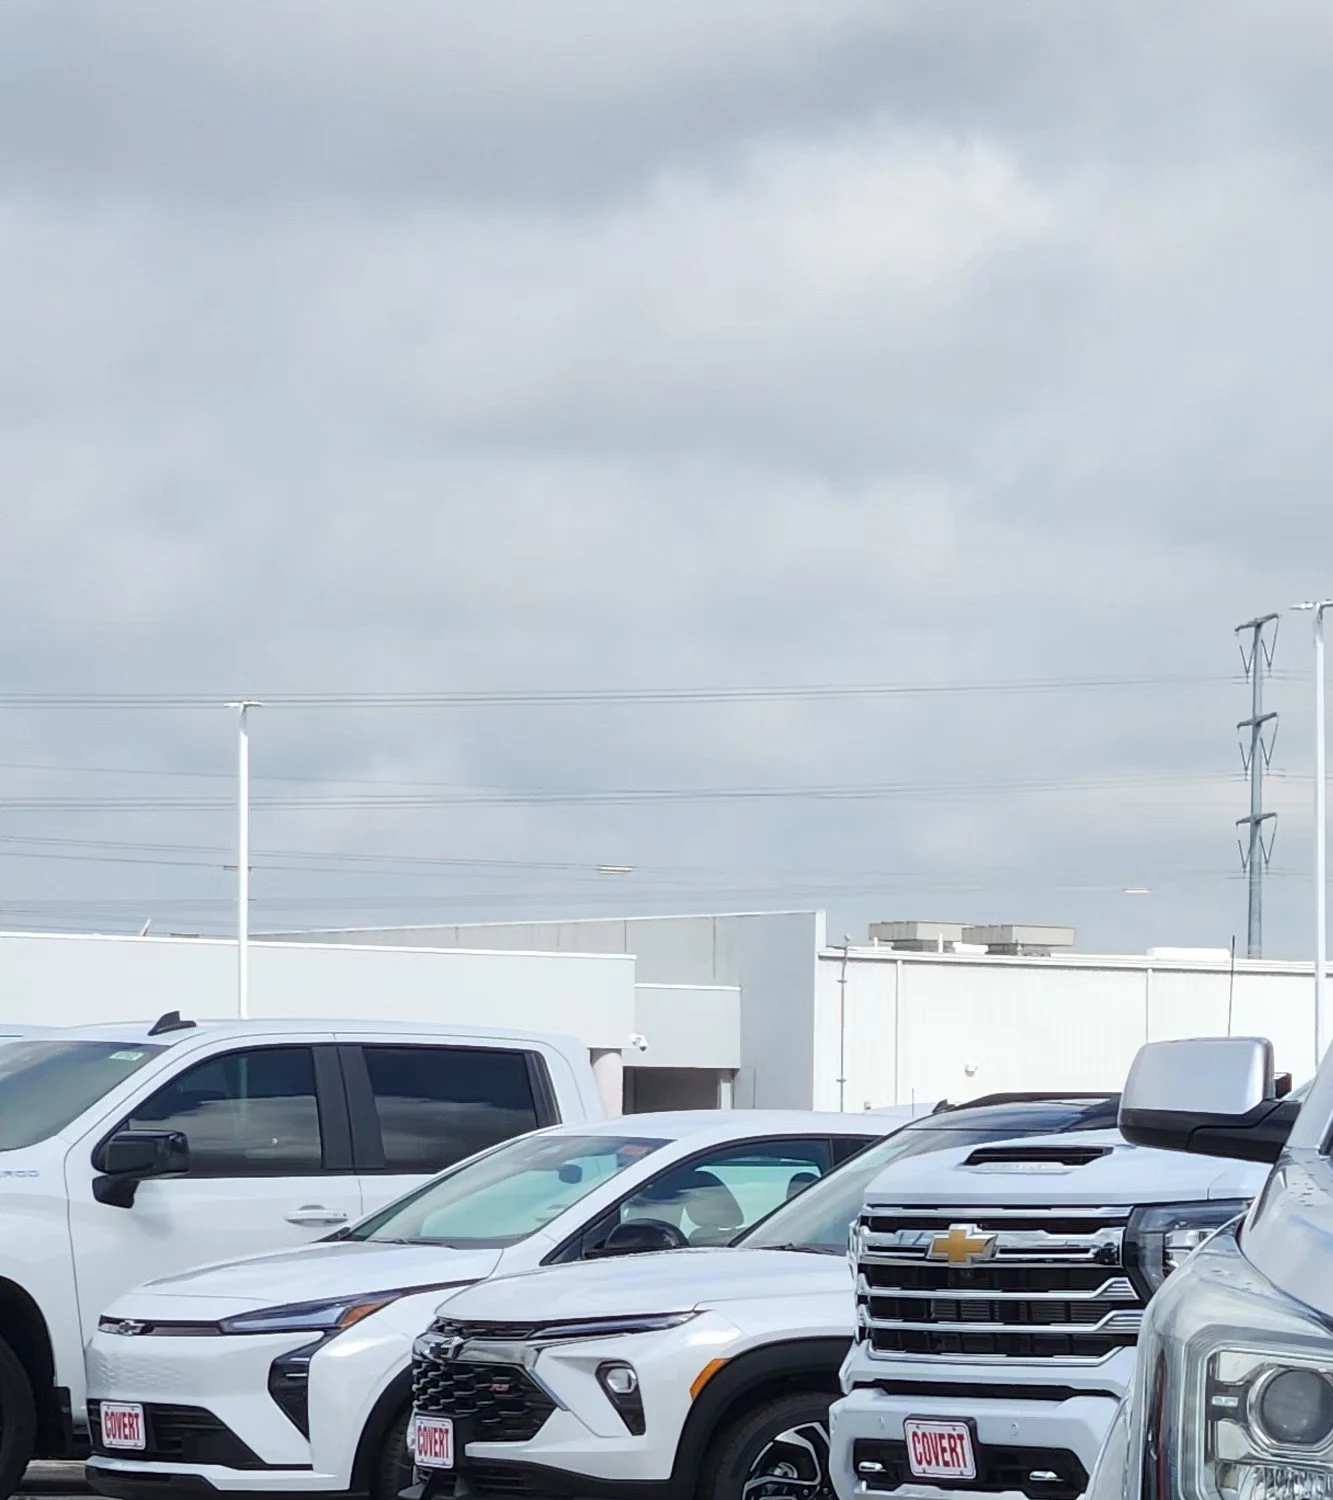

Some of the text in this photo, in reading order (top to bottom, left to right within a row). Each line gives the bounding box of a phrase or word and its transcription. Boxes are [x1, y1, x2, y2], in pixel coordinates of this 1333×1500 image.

[104, 1411, 140, 1440] COVERT
[417, 1425, 449, 1458] COVERT
[911, 1431, 967, 1468] COVERT
